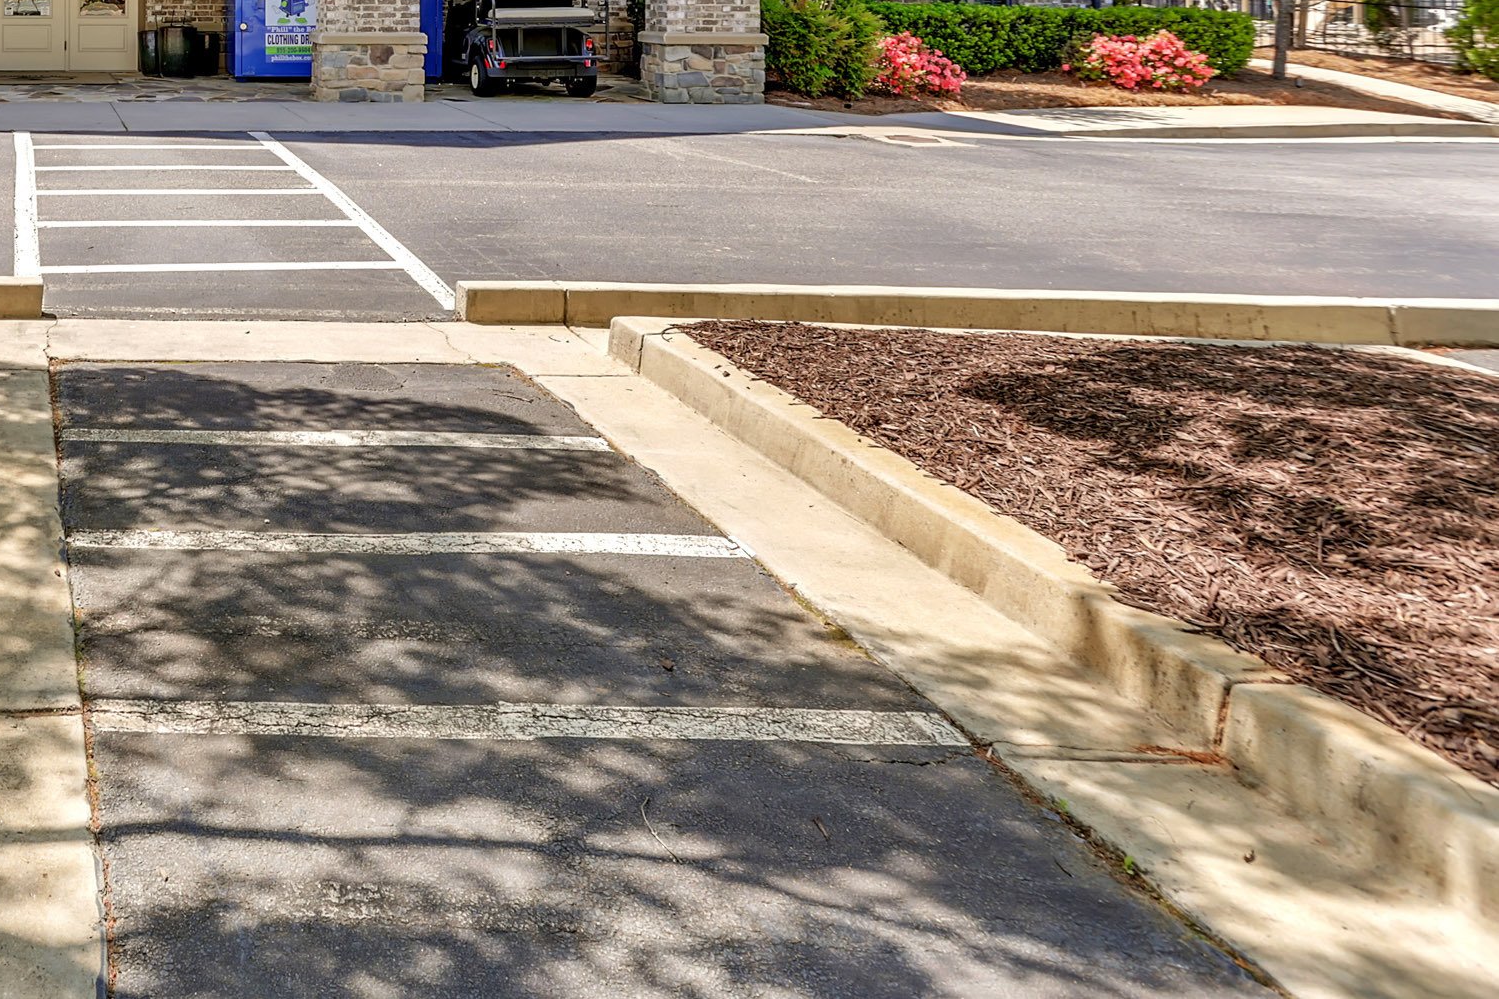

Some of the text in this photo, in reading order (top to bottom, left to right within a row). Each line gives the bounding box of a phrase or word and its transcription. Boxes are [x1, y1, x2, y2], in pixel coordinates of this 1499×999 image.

[267, 34, 312, 45] CLOTHING DR
[271, 55, 312, 63] phillthebox.co
